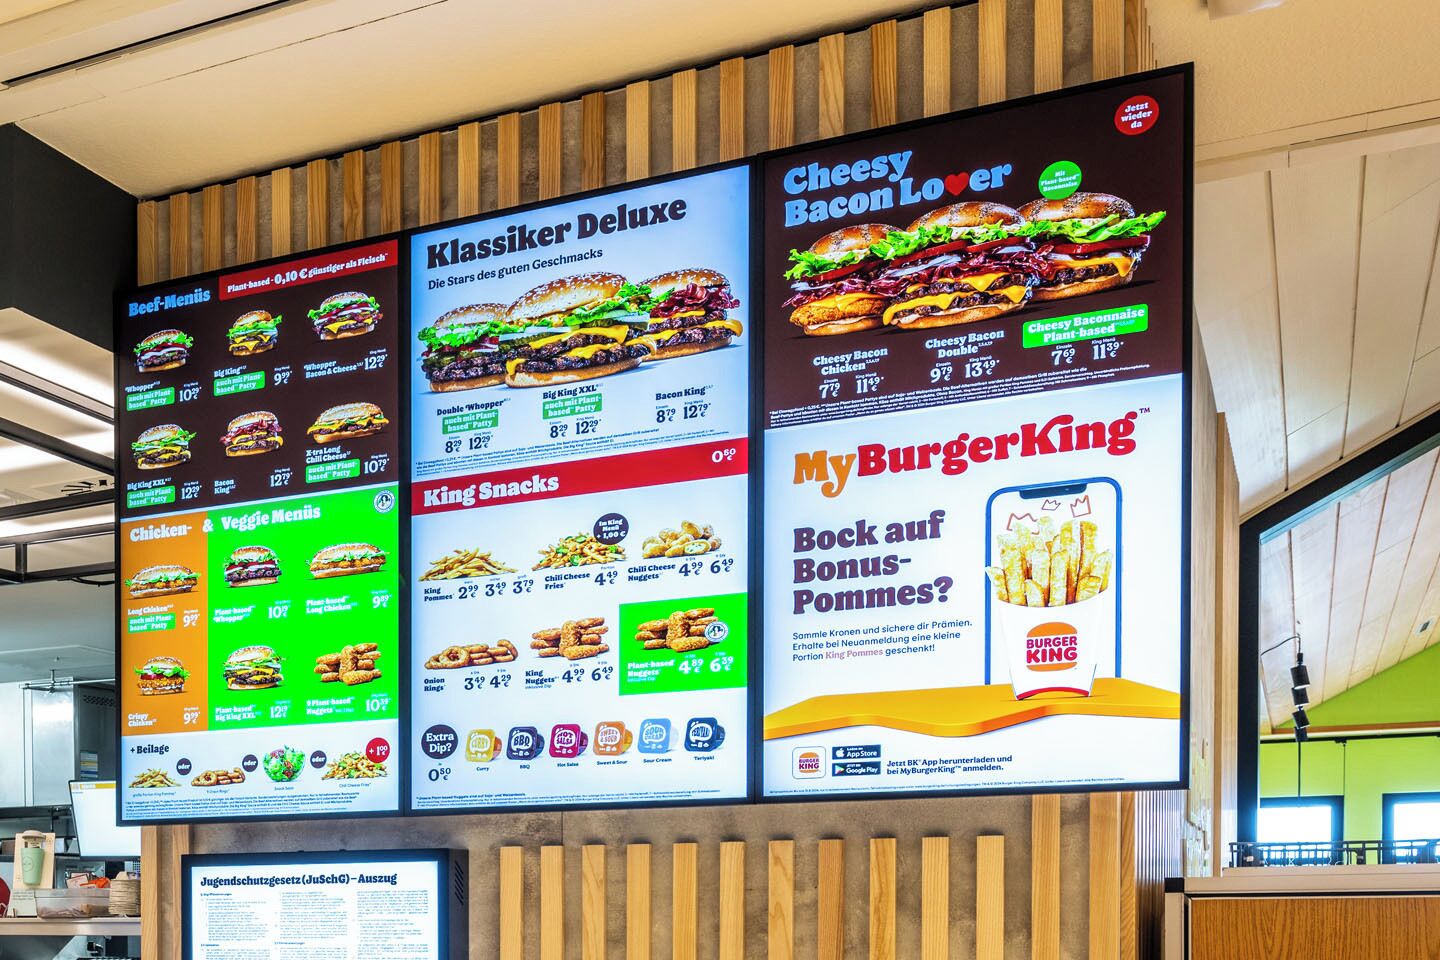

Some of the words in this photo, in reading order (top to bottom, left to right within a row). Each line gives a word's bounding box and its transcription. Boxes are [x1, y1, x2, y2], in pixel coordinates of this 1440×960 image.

[1121, 110, 1152, 122] wieder
[1125, 102, 1150, 114] Jetzt
[784, 151, 912, 194] Cheesy
[785, 180, 894, 227] Bacon
[427, 222, 571, 269] Klassiker
[578, 200, 686, 239] Deluxe
[228, 278, 270, 292] Plant-based
[274, 271, 298, 284] 0,10
[299, 268, 307, 278] €
[308, 264, 345, 278] günstiger
[346, 260, 356, 268] als
[428, 279, 445, 290] Die
[448, 274, 474, 286] Stars
[477, 270, 496, 280] des
[498, 264, 529, 278] guten
[532, 250, 602, 269] Geschmacks
[129, 289, 210, 316] Beef-Menüs
[1028, 320, 1072, 333] Cheesy
[1074, 310, 1144, 326] Baconnaise
[926, 336, 967, 348] Cheesy
[968, 331, 1004, 342] Bacon
[813, 354, 852, 366] Cheesy
[854, 348, 888, 360] Bacon
[424, 485, 476, 506] King
[479, 476, 559, 499] Snacks
[130, 524, 192, 541] Chicken-
[202, 519, 213, 532] &
[221, 512, 269, 530] Veggie
[272, 506, 320, 523] Menüs
[794, 520, 878, 553] Bock
[885, 510, 945, 543] auf
[794, 555, 911, 584] Bonus-
[794, 576, 953, 614] Pommes?
[793, 631, 827, 640] Sammle
[863, 626, 879, 634] und
[917, 622, 929, 630] dir
[932, 620, 972, 628] Prämien.
[793, 642, 824, 650] Erhalte
[826, 640, 839, 648] bei
[842, 636, 909, 646] Neuanmeldung
[934, 632, 960, 640] kleine
[1027, 633, 1077, 648] BURGER
[793, 653, 823, 661] Portion
[826, 651, 845, 660] King
[885, 644, 934, 656] geschenkt!
[1027, 647, 1077, 663] KING
[426, 733, 454, 742] Extra
[137, 745, 169, 754] Beilage
[430, 743, 452, 753] Dip?
[176, 762, 192, 771] oder
[242, 758, 258, 768] oder
[312, 754, 326, 762] oder
[939, 756, 995, 764] herunterladen
[846, 765, 866, 774] Google
[201, 876, 301, 888] Jugendschutzgesetz
[302, 874, 350, 885] (JuSchG)
[358, 874, 397, 885] Auszug
